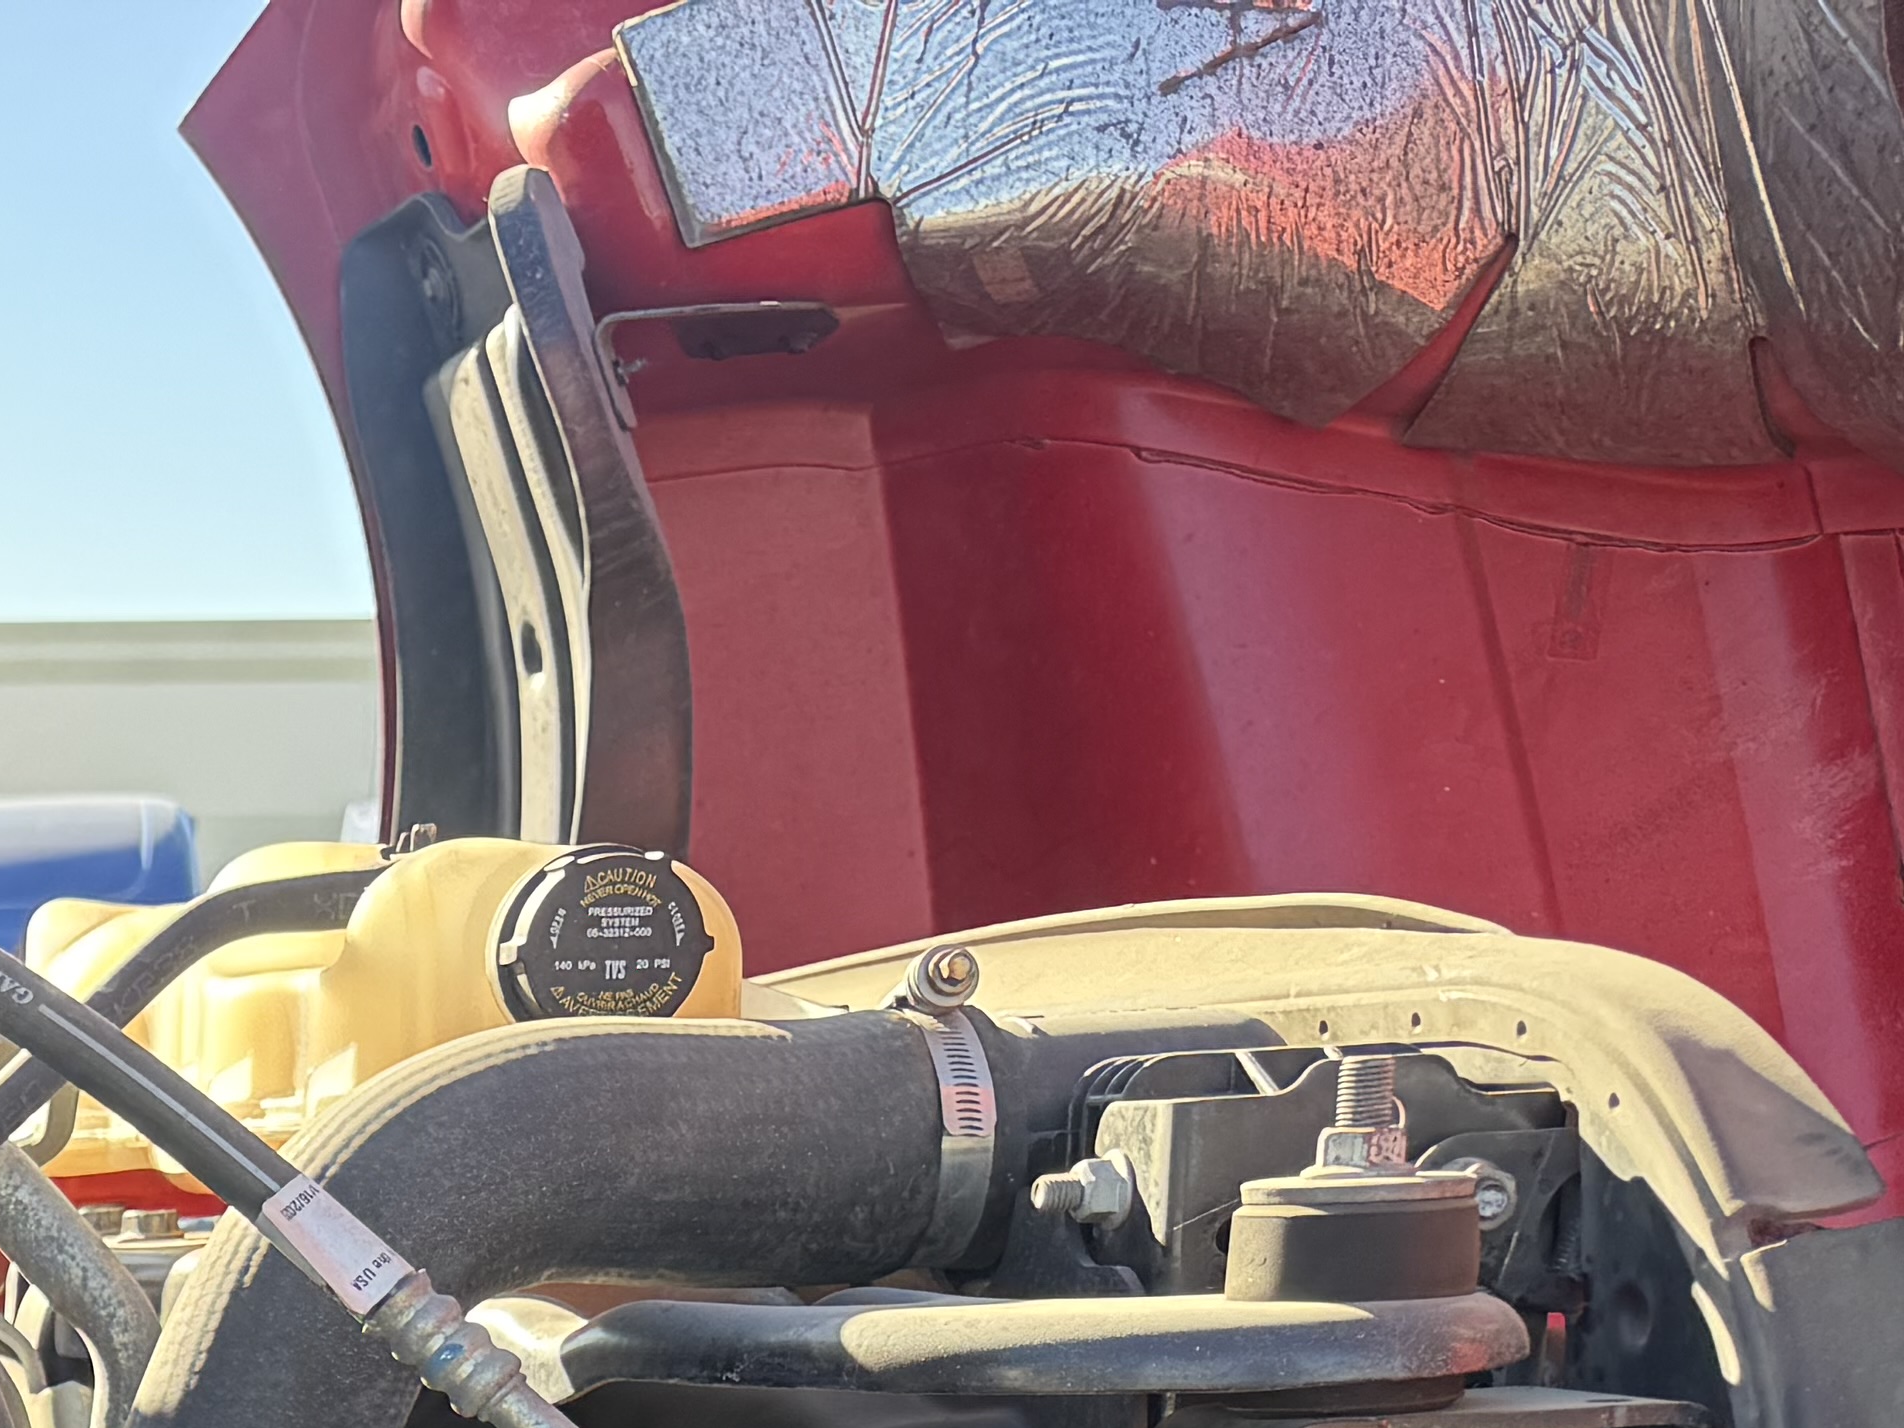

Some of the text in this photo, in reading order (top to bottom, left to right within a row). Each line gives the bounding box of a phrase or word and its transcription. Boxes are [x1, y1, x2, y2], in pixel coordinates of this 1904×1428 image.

[597, 867, 657, 888] CAUTION
[588, 906, 653, 916] PRESSURIZED
[600, 917, 639, 927] SYSTEM
[554, 960, 572, 970] 140
[577, 960, 596, 970] kPa
[636, 959, 648, 969] 20
[654, 958, 670, 968] PSI
[348, 1266, 377, 1292] USA
